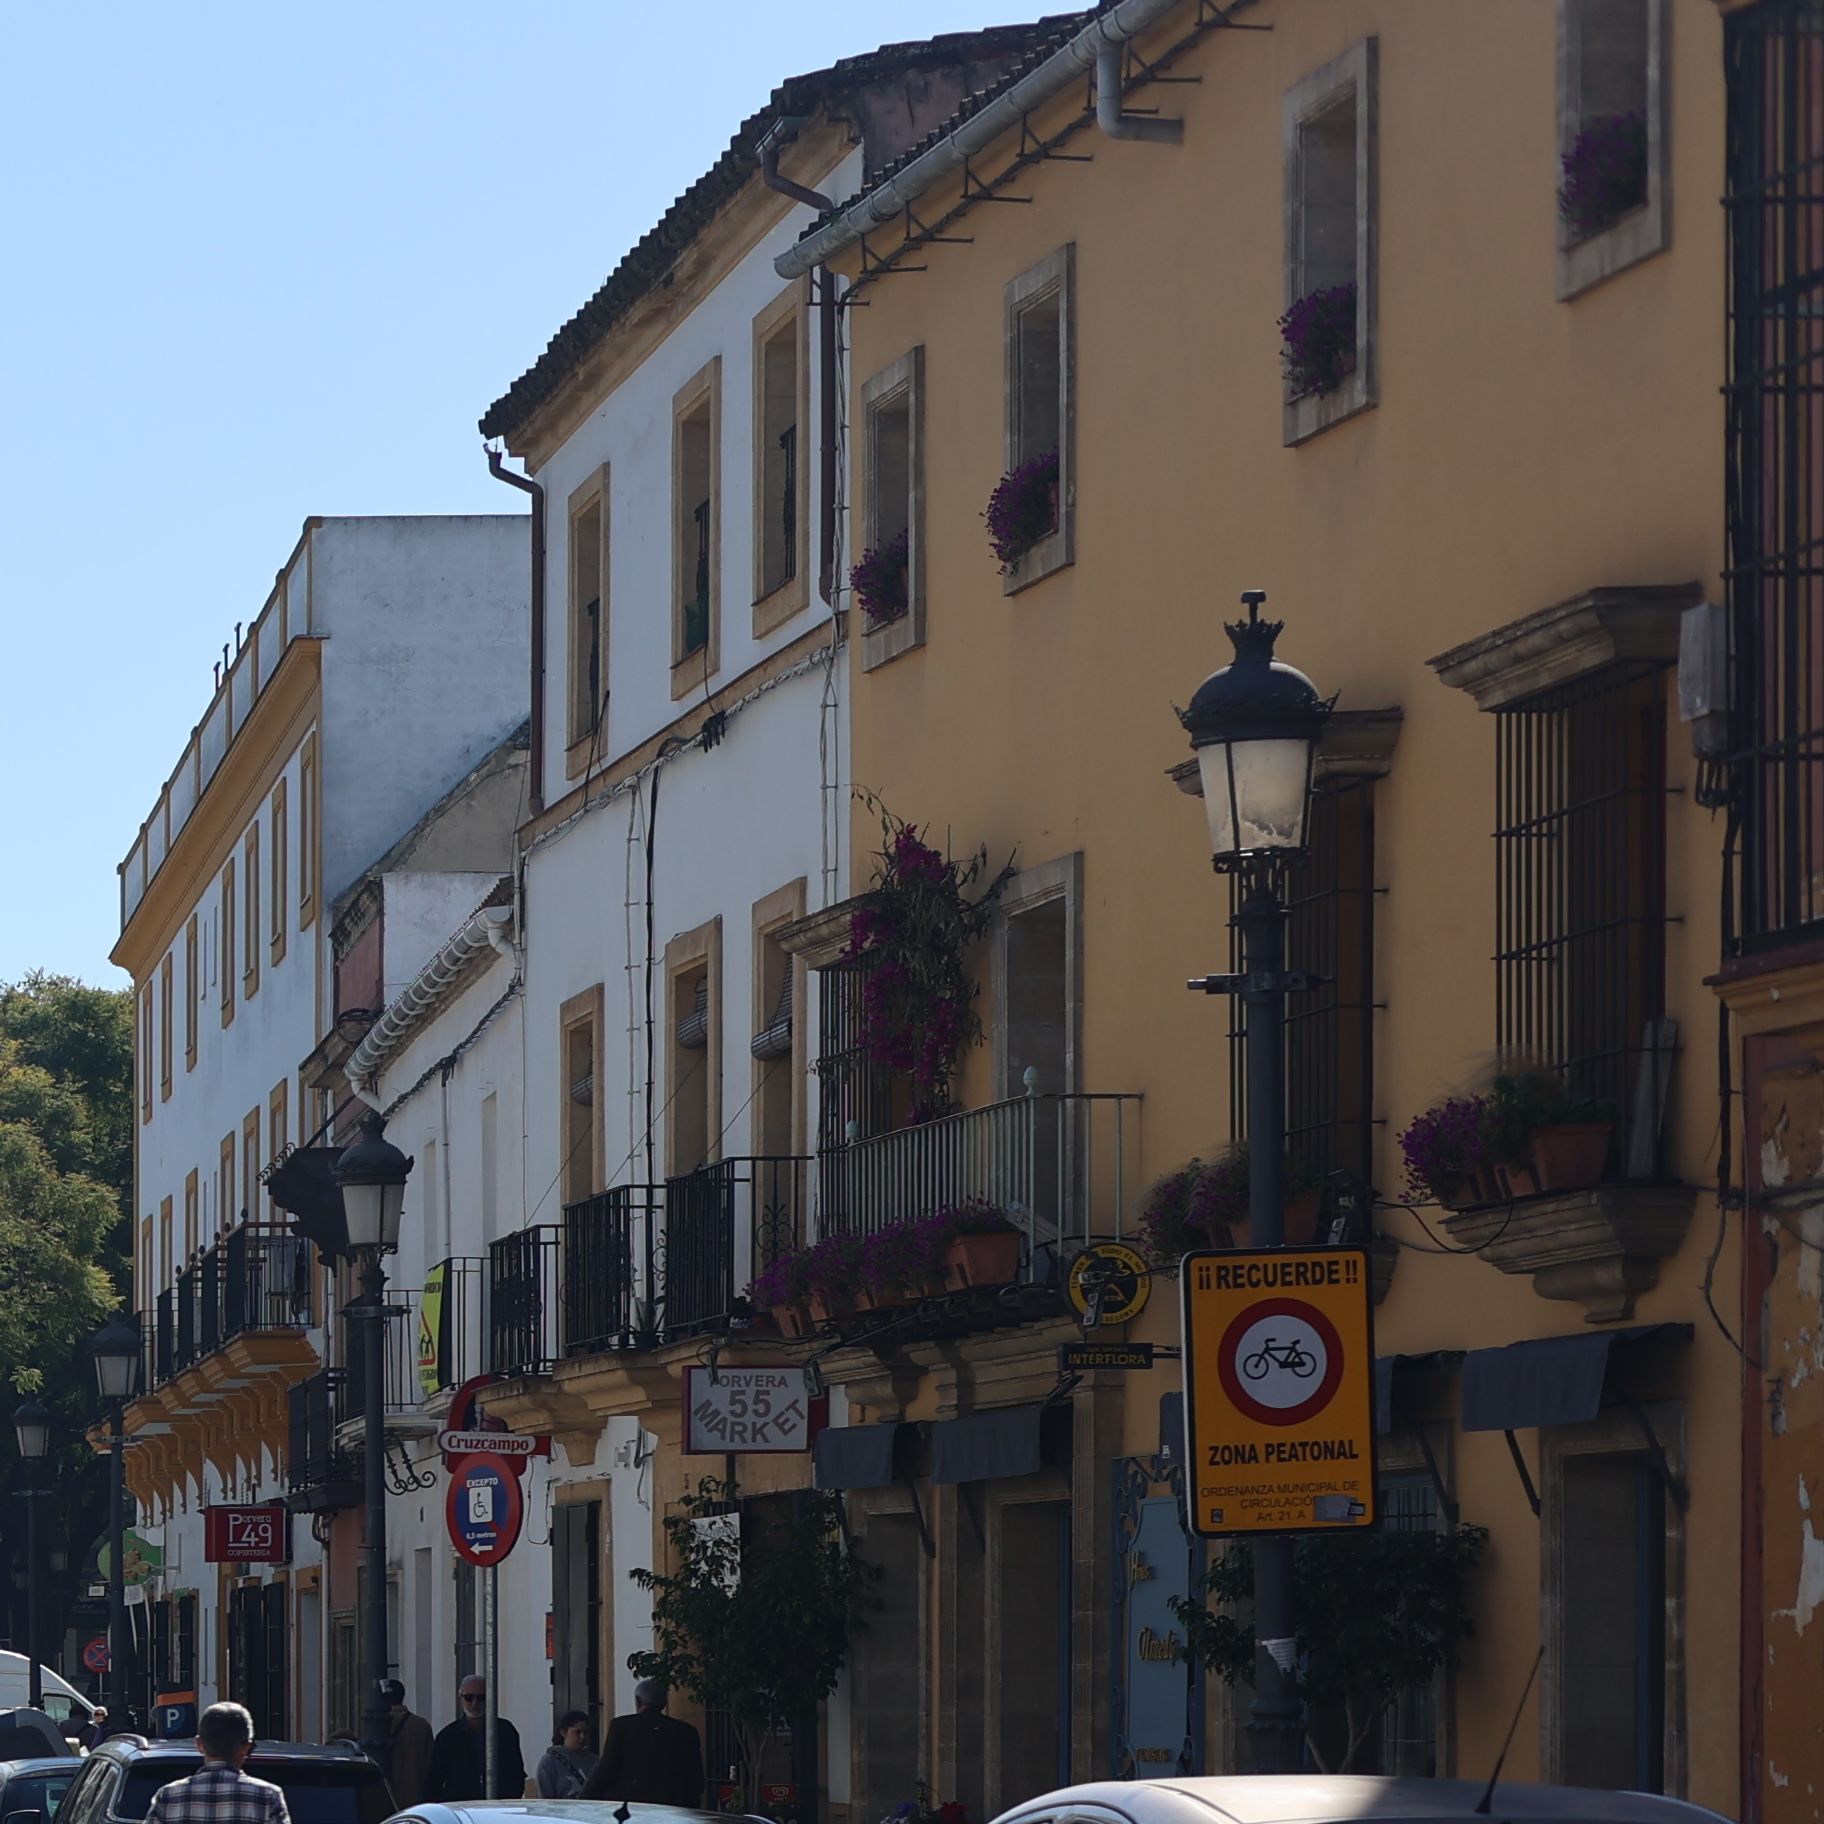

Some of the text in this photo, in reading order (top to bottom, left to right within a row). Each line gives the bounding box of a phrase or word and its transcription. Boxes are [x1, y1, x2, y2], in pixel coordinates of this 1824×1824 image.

[1068, 1353, 1147, 1366] INTERFLORA
[728, 1389, 772, 1419] 55
[693, 1398, 806, 1444] MARKET
[447, 1434, 529, 1451] Cruzcampo
[1209, 1440, 1359, 1466] ZONA PEATONAL
[1201, 1480, 1359, 1498] ORDENANZA MUNICIPAL DE
[1240, 1496, 1314, 1510] CIRCULACIÓ
[1297, 1510, 1306, 1520] A
[240, 1523, 272, 1548] 49
[166, 1709, 180, 1728] P
